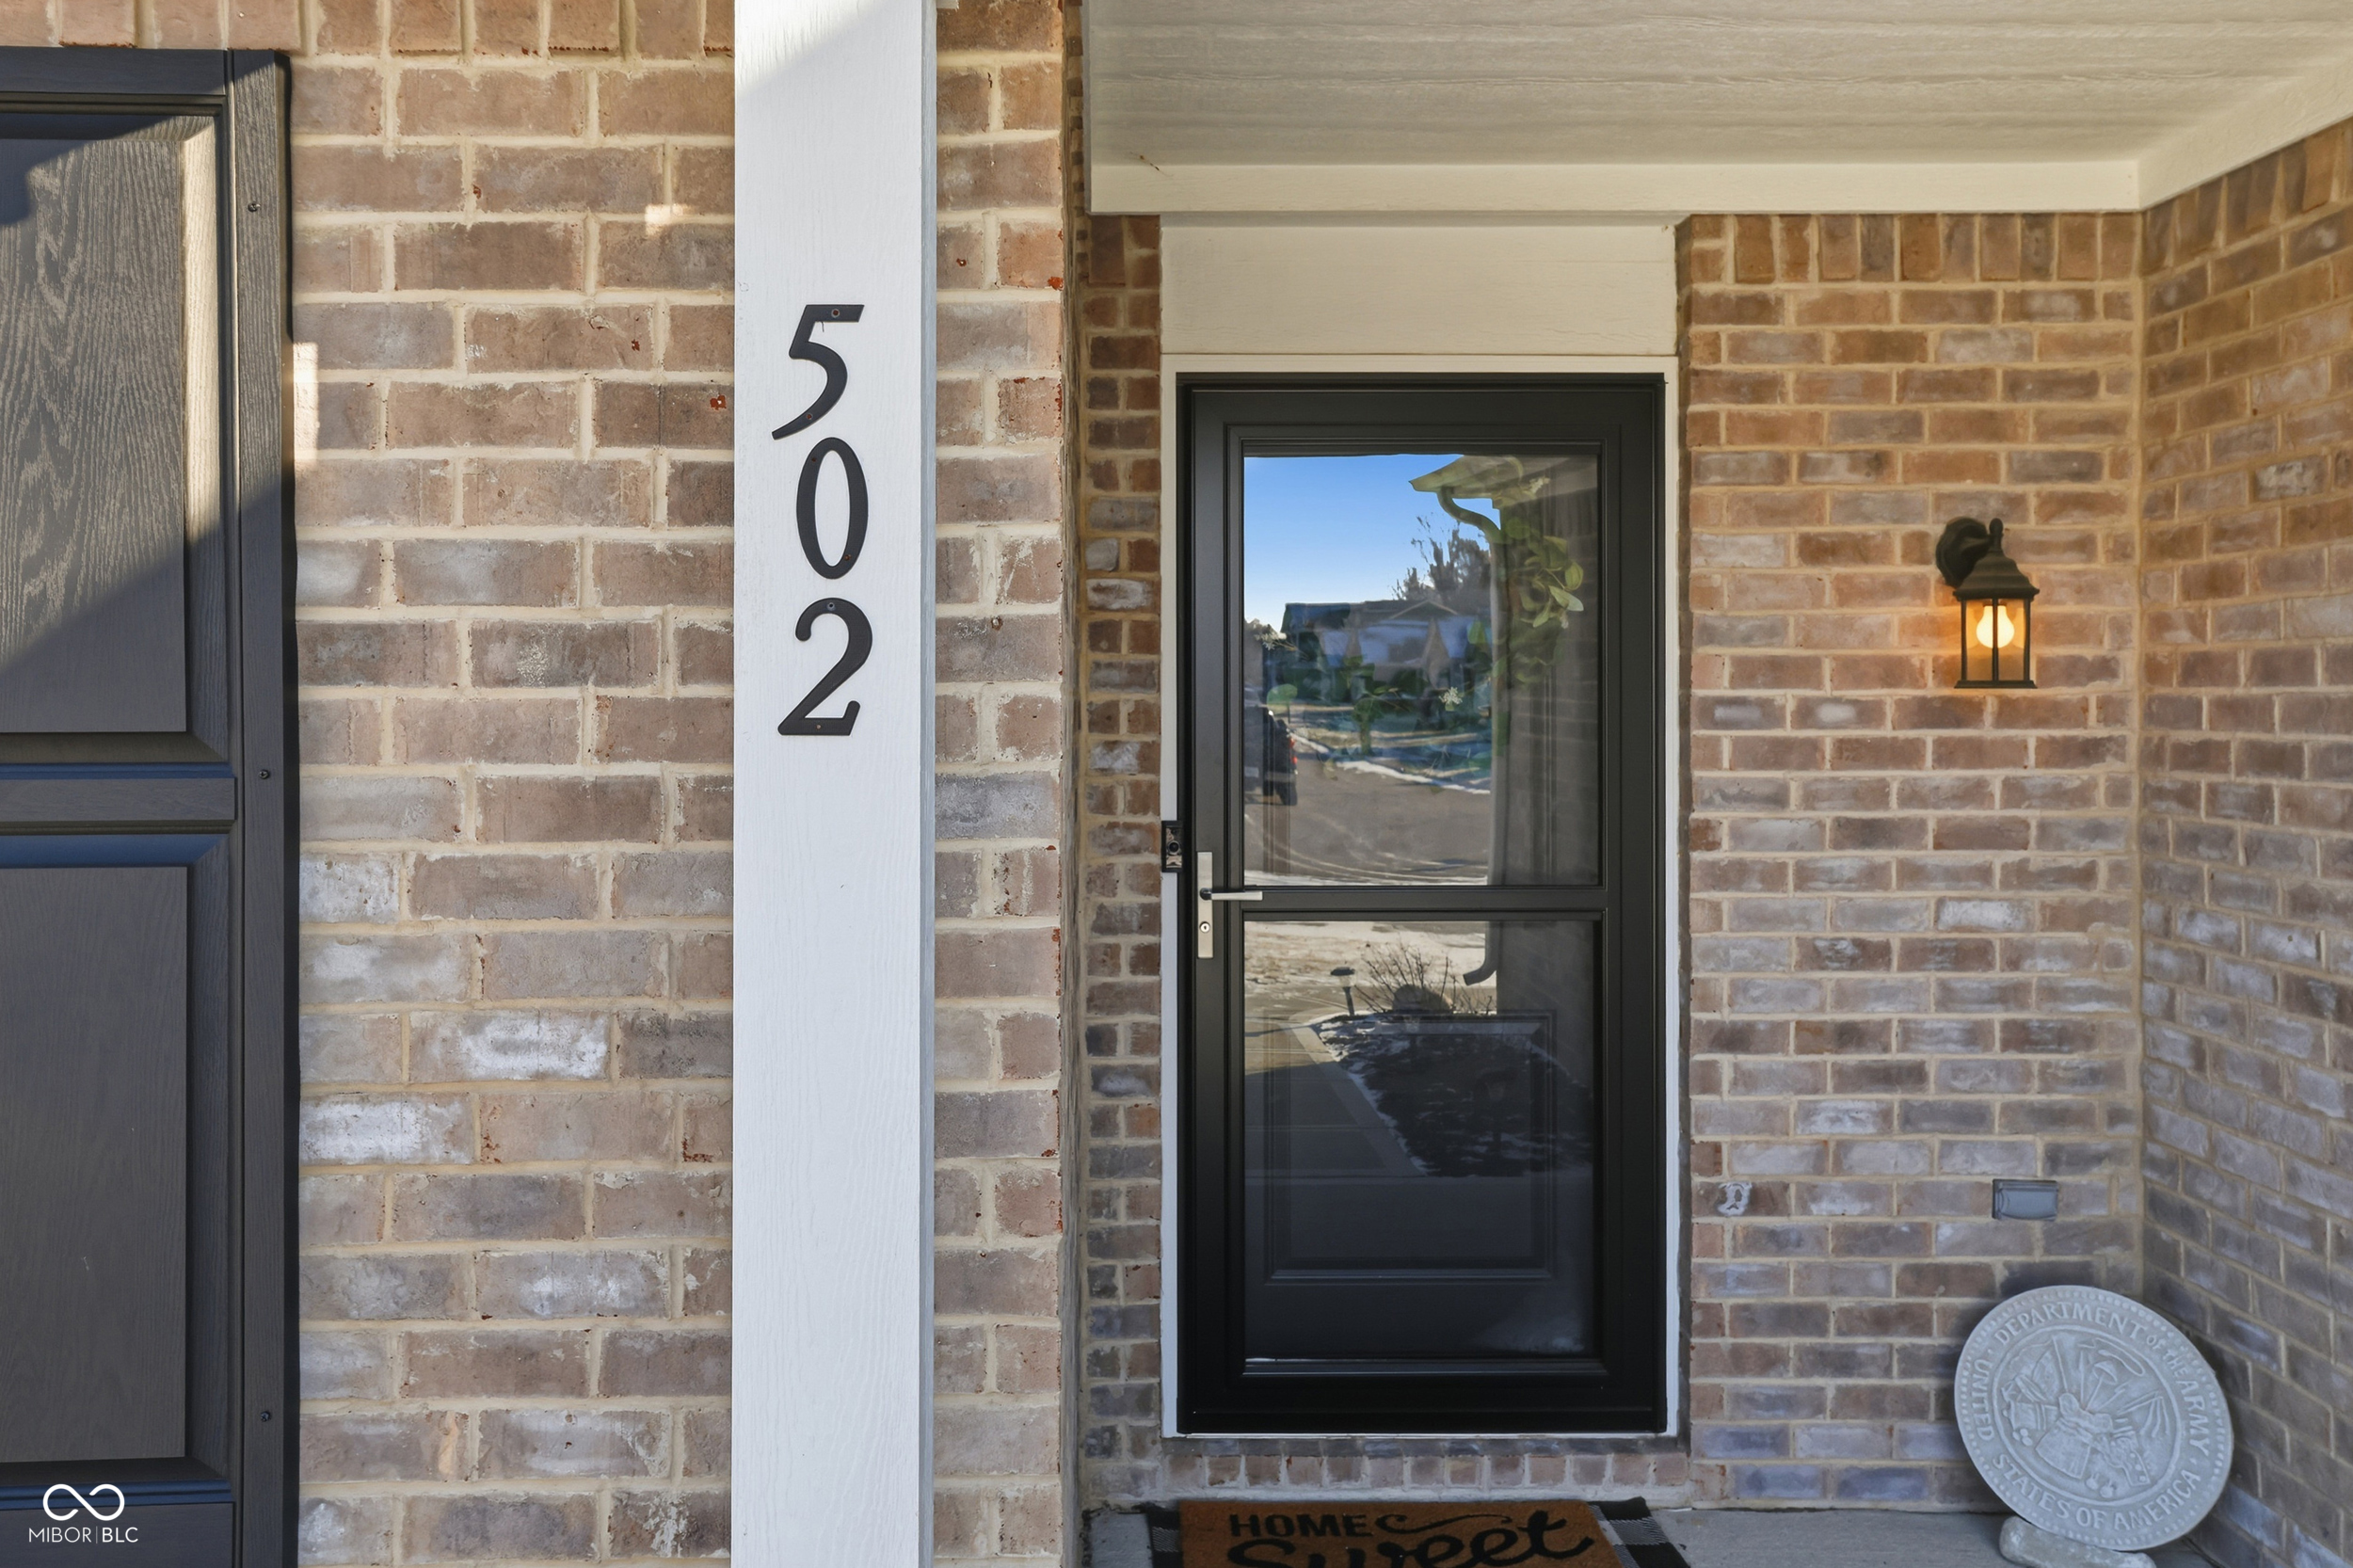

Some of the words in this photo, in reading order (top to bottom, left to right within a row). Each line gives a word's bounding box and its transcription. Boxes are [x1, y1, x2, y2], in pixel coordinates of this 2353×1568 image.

[772, 304, 872, 736] 502
[1972, 1360, 1994, 1441] UNITED
[1993, 1454, 2071, 1519] STATES
[2075, 1508, 2106, 1529] OF
[2114, 1469, 2201, 1530] AMERICA
[1994, 1302, 2146, 1346] DEPARTMENT
[2176, 1380, 2209, 1457] ARMY
[1229, 1512, 1374, 1538] HOME
